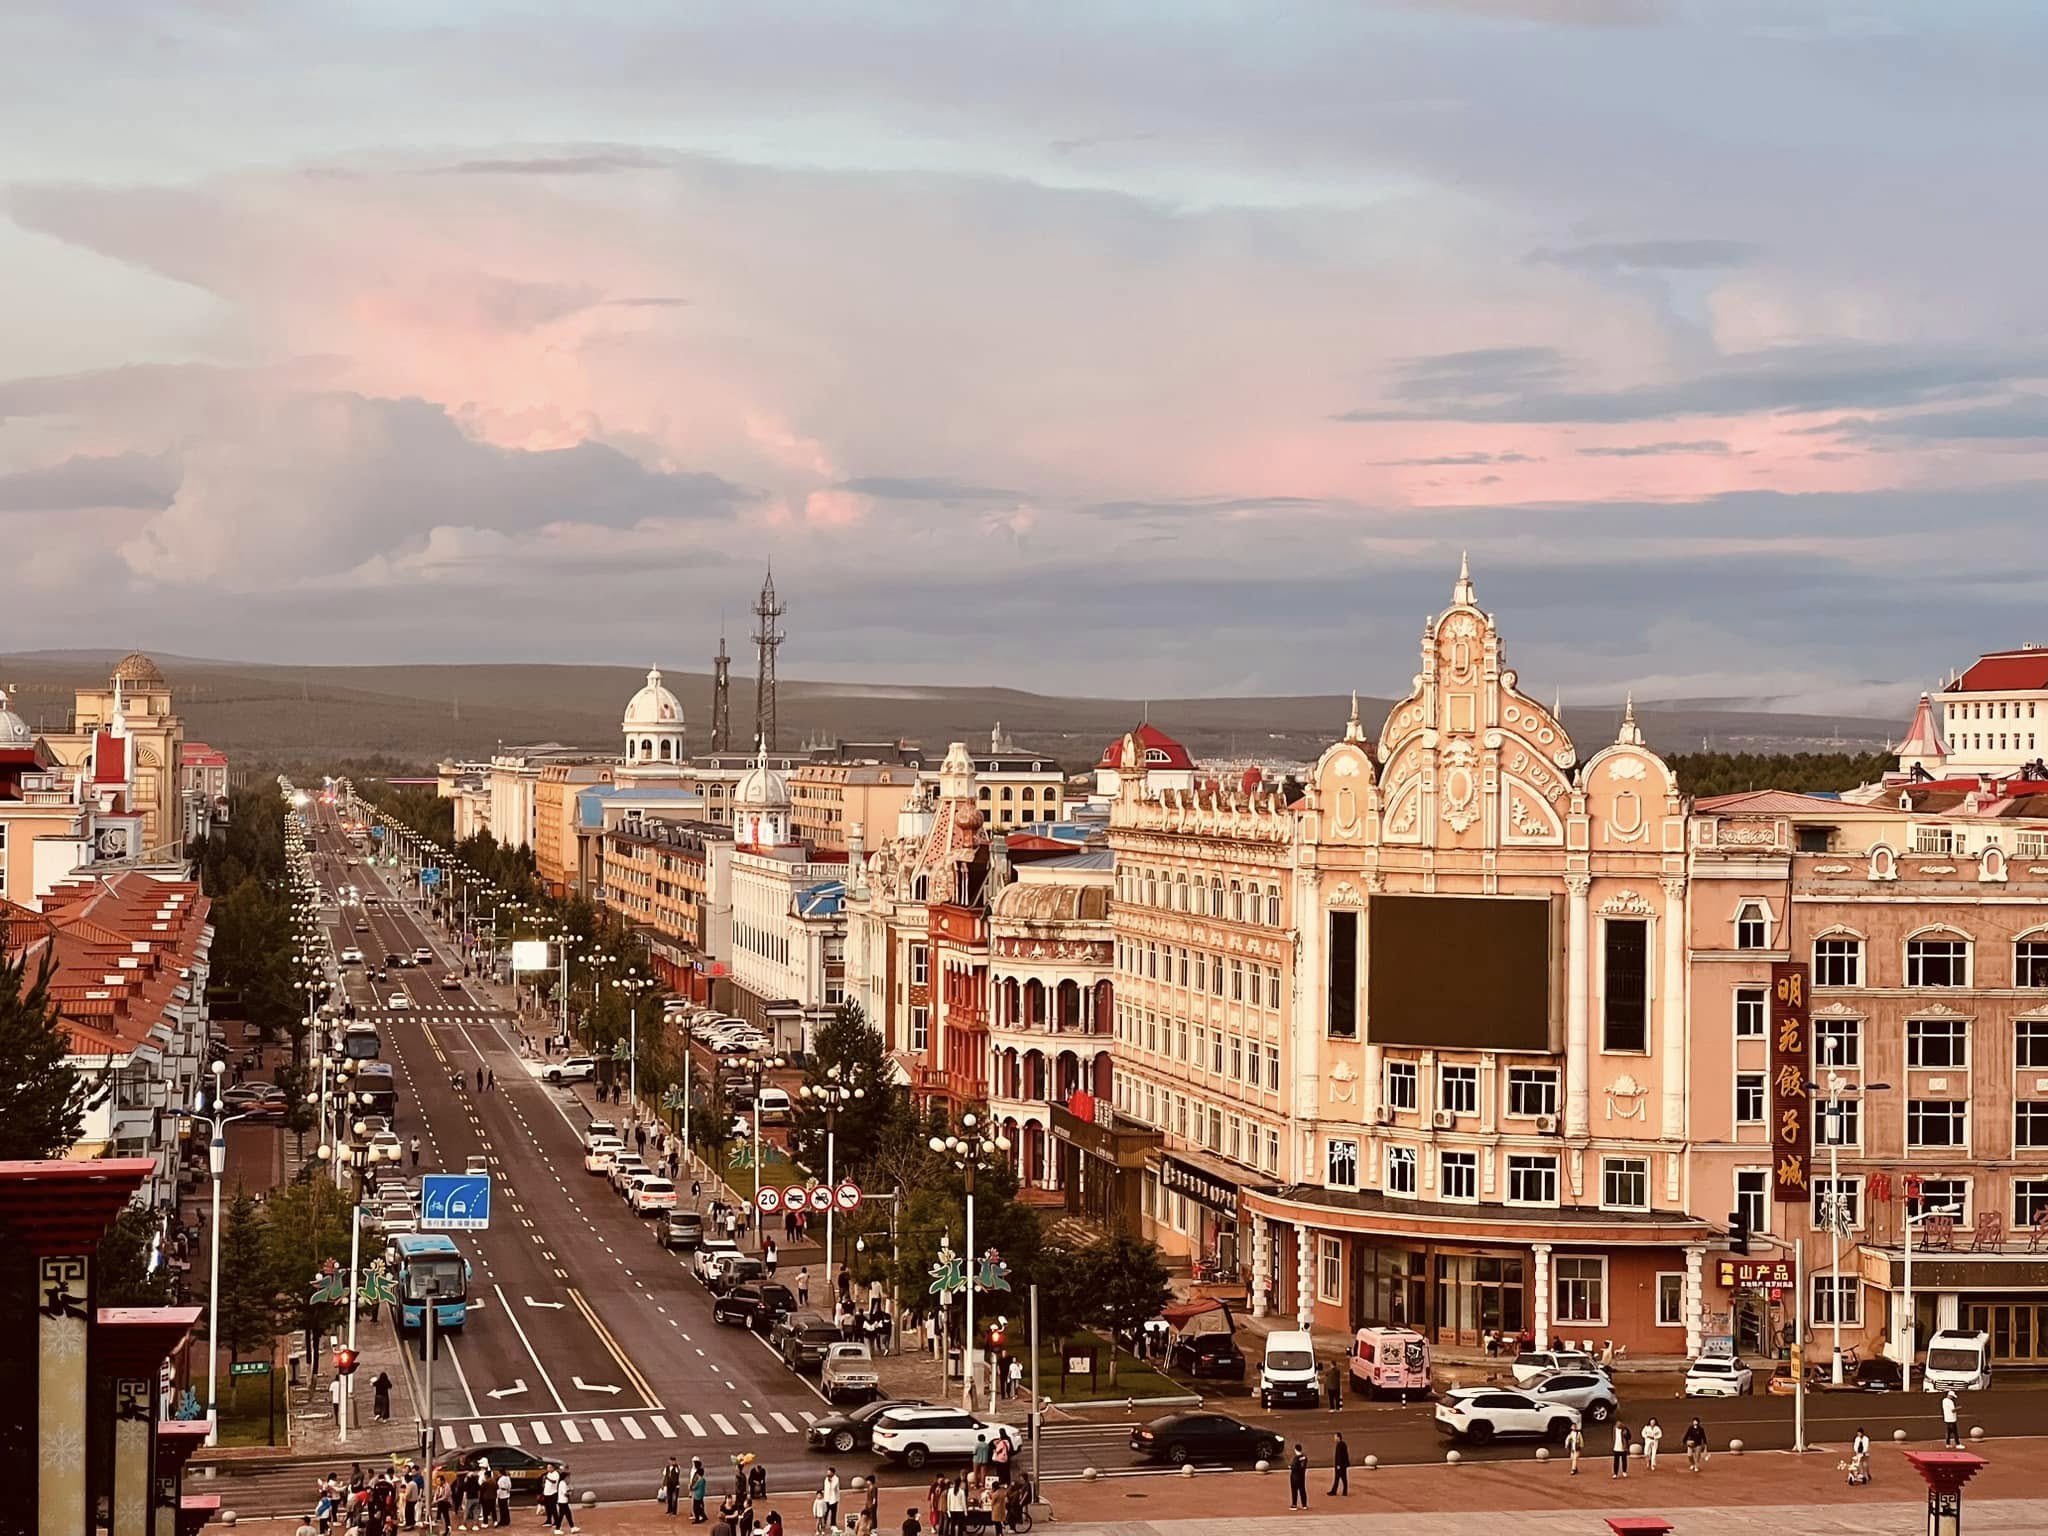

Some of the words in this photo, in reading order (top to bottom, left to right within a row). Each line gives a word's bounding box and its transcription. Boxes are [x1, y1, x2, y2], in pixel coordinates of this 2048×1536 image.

[1775, 973, 1807, 1191] 明苑餃子城
[761, 1193, 777, 1206] 20
[1740, 1265, 1788, 1280] 山产品
